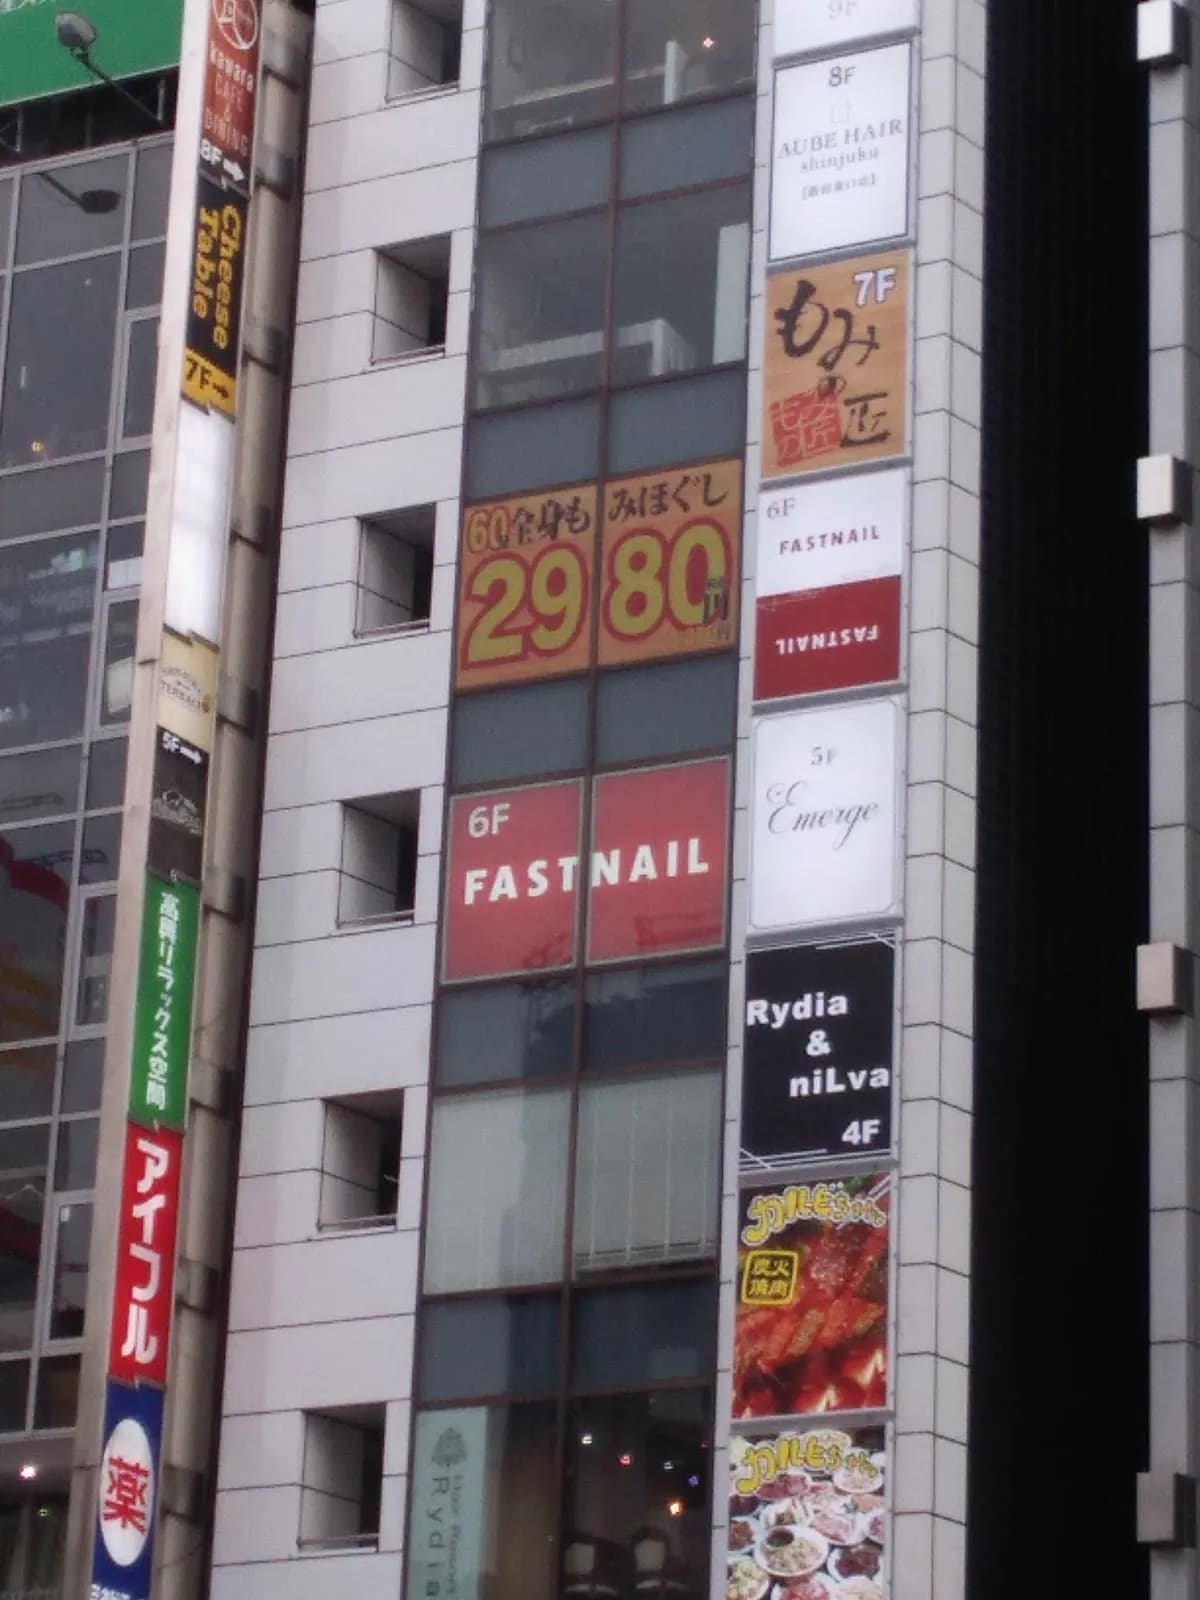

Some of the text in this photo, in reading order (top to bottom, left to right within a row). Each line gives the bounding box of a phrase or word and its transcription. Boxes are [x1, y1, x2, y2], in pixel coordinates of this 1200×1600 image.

[827, 66, 856, 87] 8F
[776, 119, 904, 159] AUBE HAIR
[800, 145, 880, 173] shinjuku
[193, 207, 220, 320] Table
[213, 205, 241, 350] Cheese
[853, 268, 896, 307] 7F
[185, 358, 213, 391] 7F
[766, 497, 796, 519] 6F
[779, 525, 881, 554] FASTNAIL
[775, 624, 879, 656] FASTNAIL
[811, 746, 837, 766] 5F
[468, 803, 511, 838] 6F
[766, 780, 880, 851] Emerge
[464, 838, 709, 904] FASTNAIL
[746, 992, 849, 1028] Rydia
[806, 1030, 832, 1056] &
[789, 1067, 891, 1097] niLva
[841, 1119, 881, 1144] 4F
[121, 1137, 169, 1364] アイフル
[103, 1456, 150, 1536] 薬
